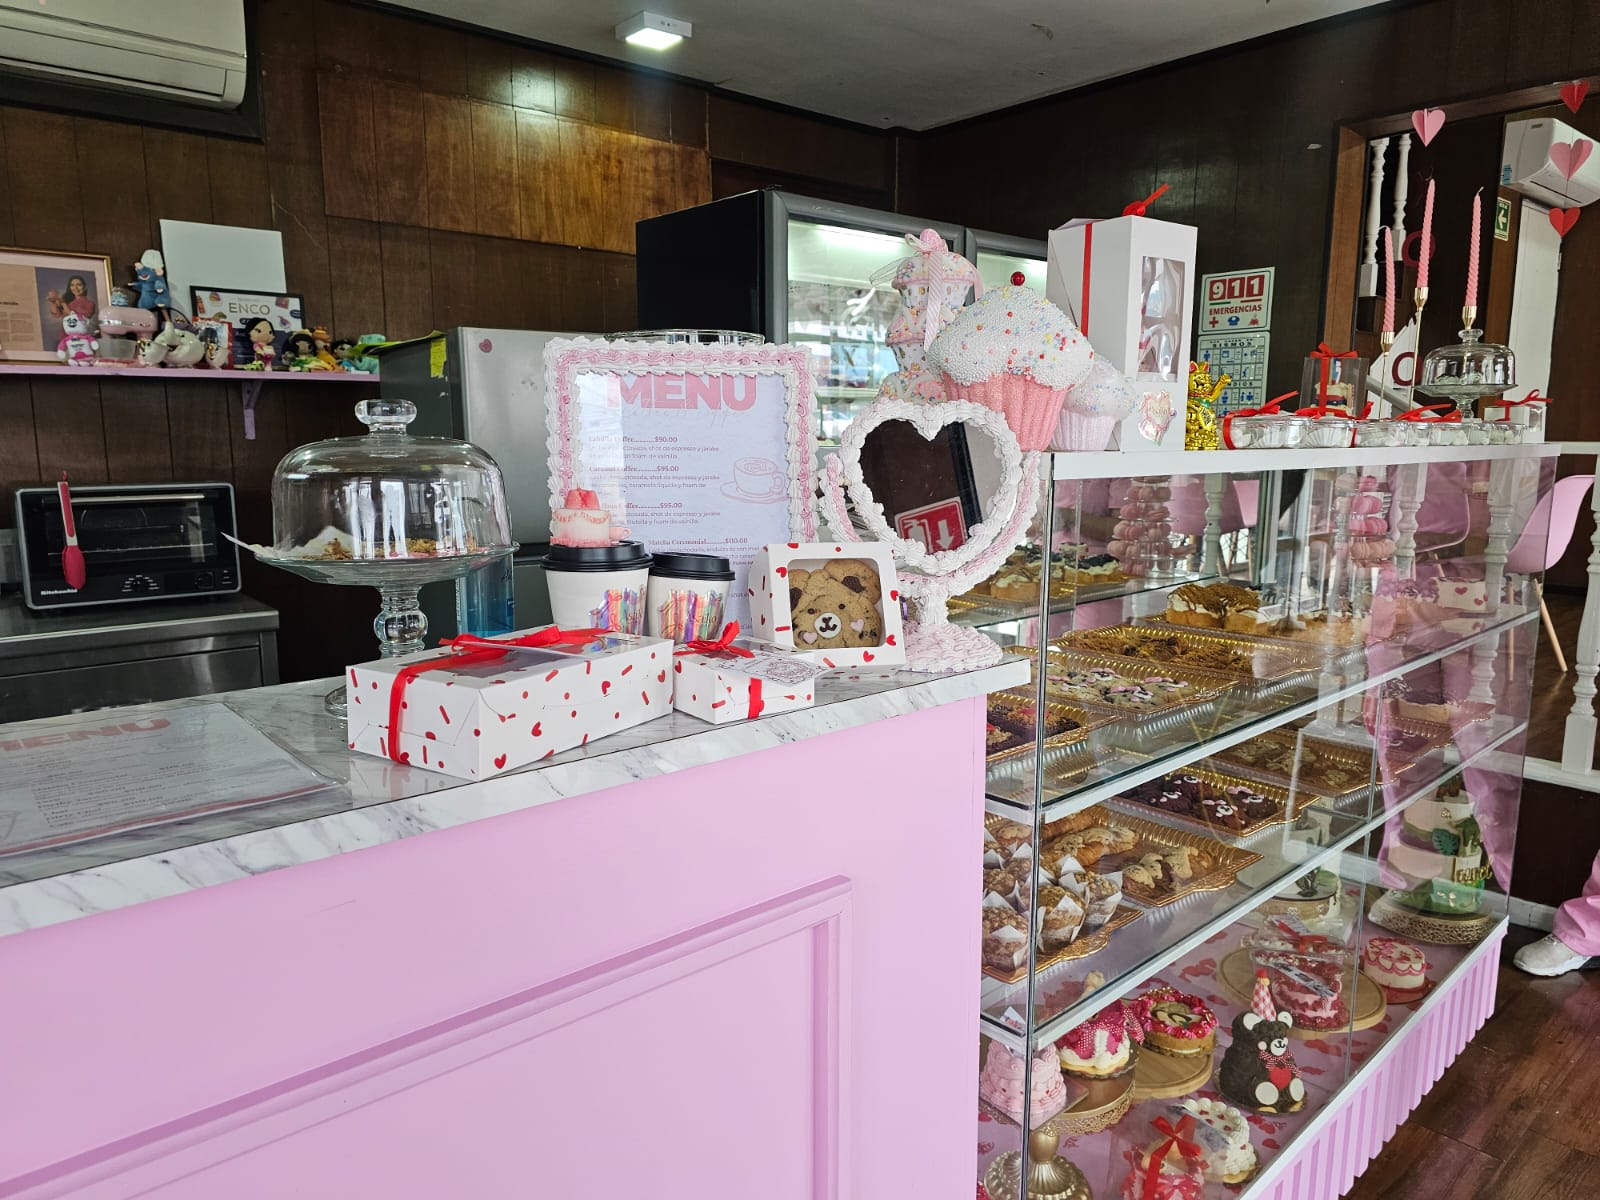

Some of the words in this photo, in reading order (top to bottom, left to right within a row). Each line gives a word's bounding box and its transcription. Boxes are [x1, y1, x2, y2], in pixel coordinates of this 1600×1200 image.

[1211, 276, 1261, 300] 911
[1208, 304, 1262, 316] EMERGENCIAS
[607, 372, 757, 411] MENU
